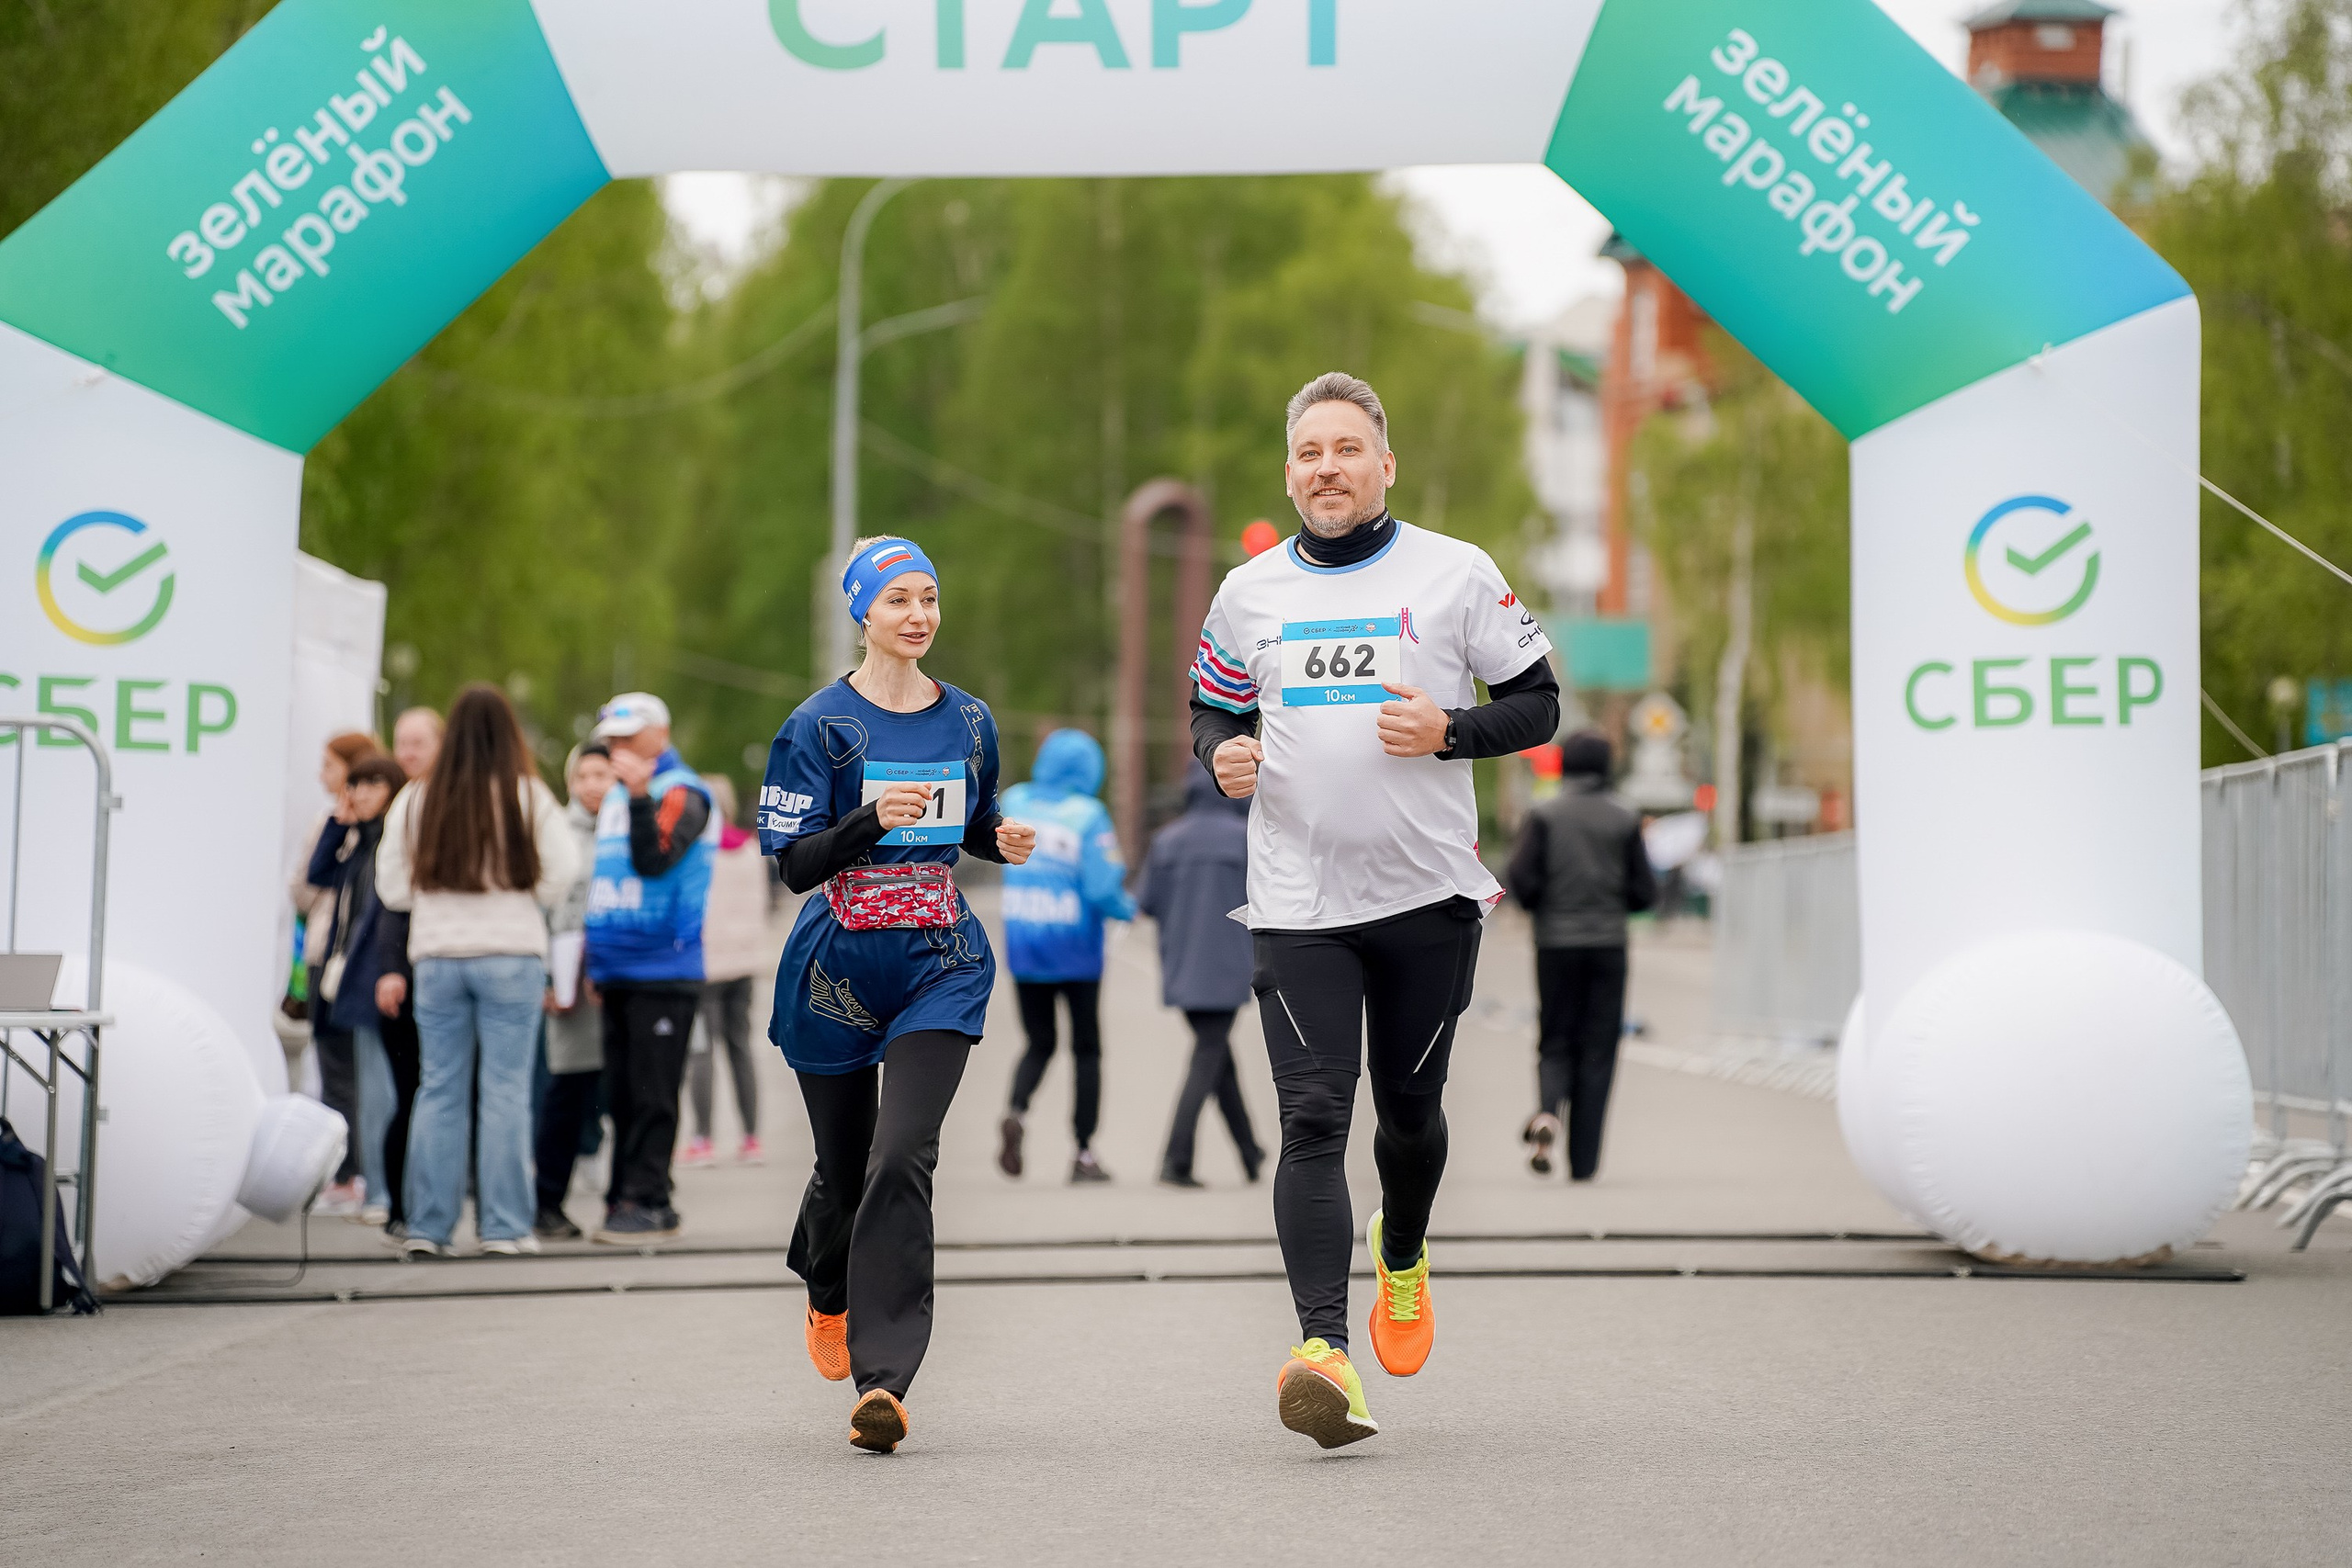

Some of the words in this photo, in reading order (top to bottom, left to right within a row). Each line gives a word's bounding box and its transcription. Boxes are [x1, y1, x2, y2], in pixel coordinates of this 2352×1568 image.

[165, 24, 427, 279] зелёный
[210, 85, 472, 330] марафон
[1662, 73, 1924, 314] марафон
[1709, 27, 1982, 267] зелёный
[1305, 644, 1375, 679] 662
[1905, 657, 2164, 729] СБЕР
